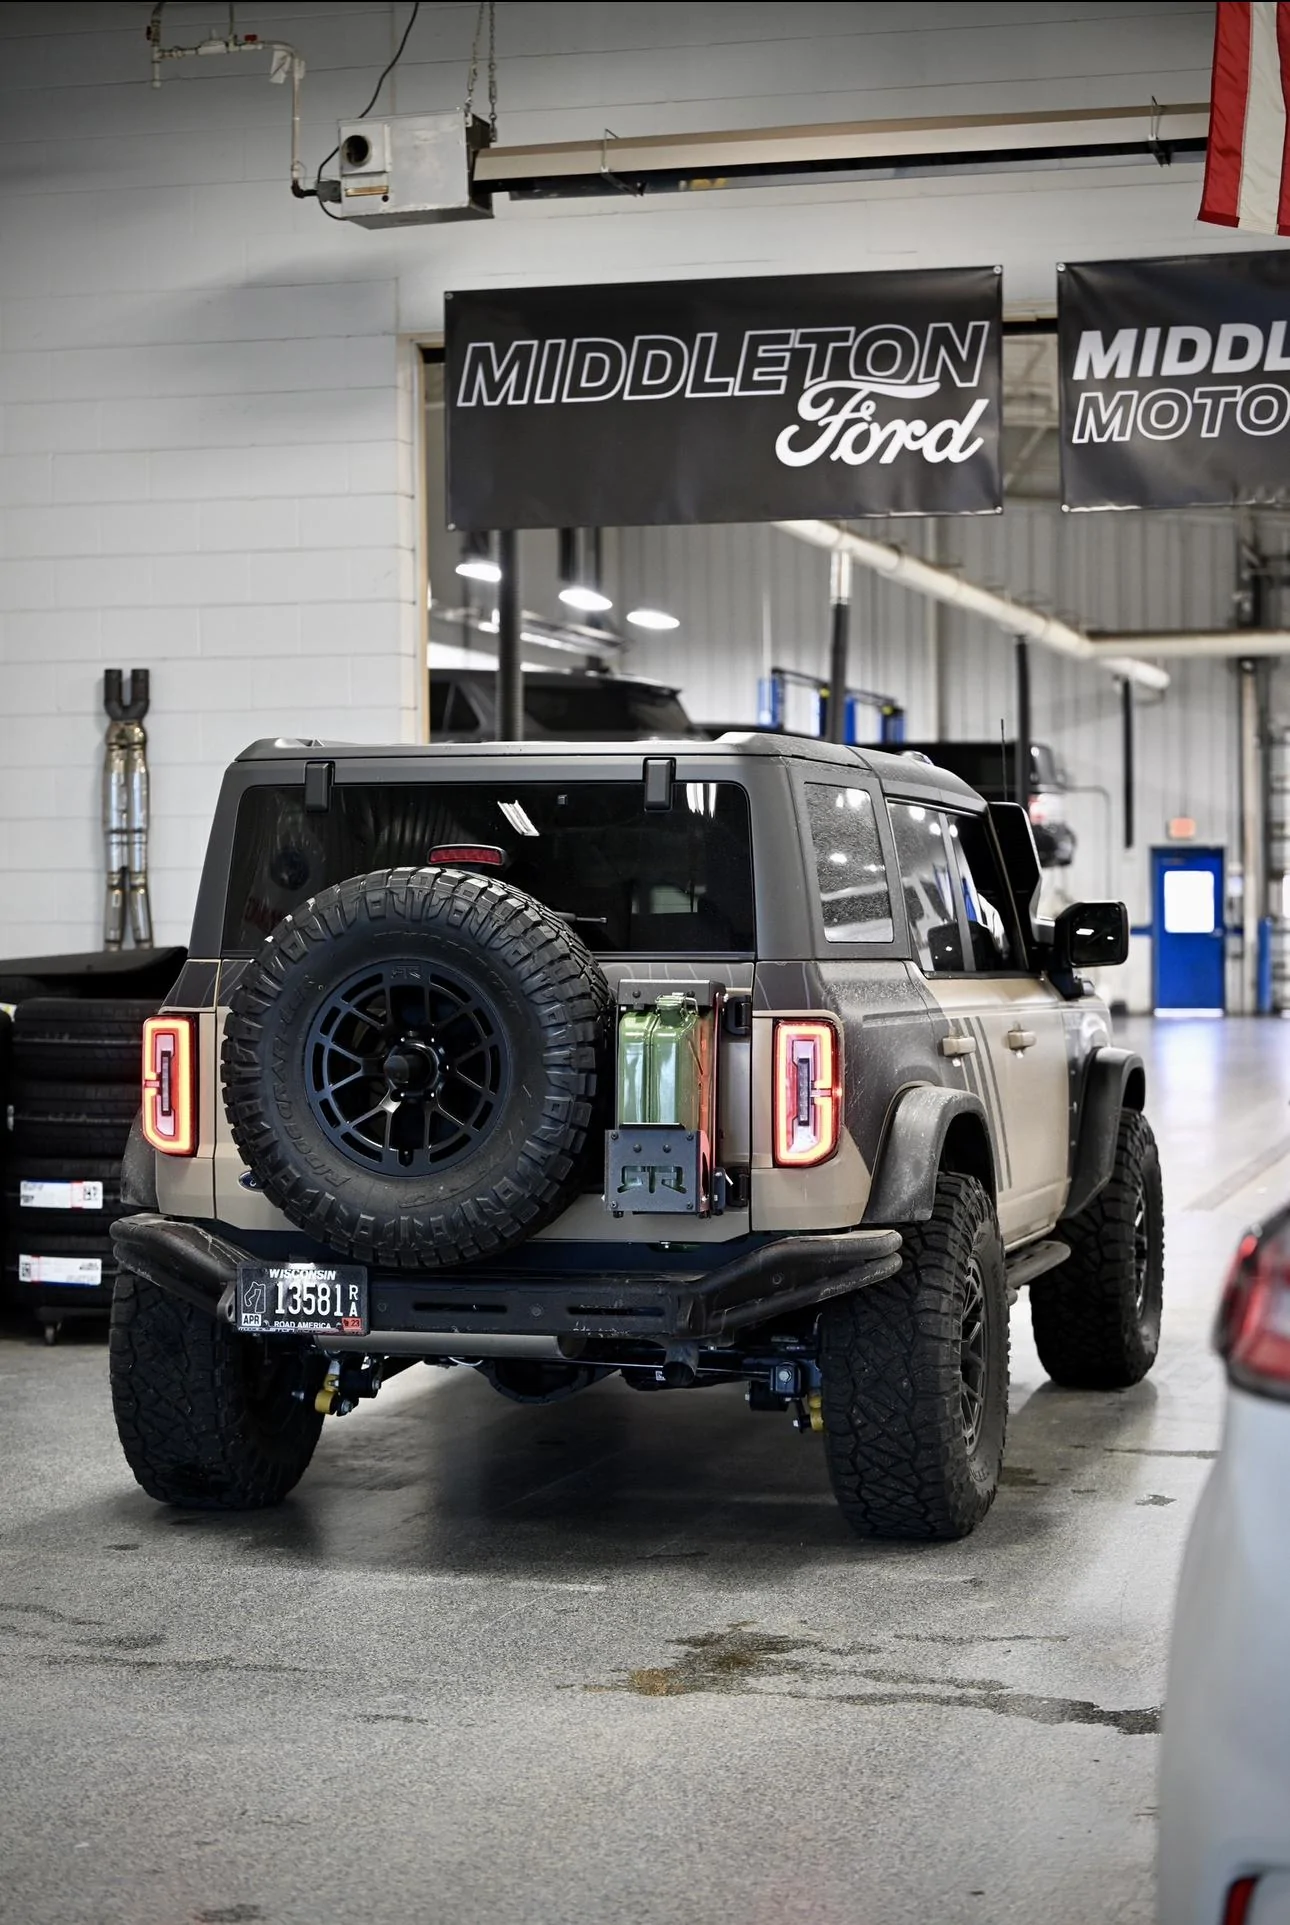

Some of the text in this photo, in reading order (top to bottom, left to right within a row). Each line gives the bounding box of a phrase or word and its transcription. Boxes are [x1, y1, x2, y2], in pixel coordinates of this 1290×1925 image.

[456, 320, 990, 407] MIDDLETON
[1072, 320, 1290, 381] MIDDL
[775, 380, 990, 467] Ford
[1072, 383, 1290, 444] MOTO
[269, 1268, 337, 1281] WISCONSIN
[242, 1314, 260, 1325] APR
[274, 1281, 344, 1317] 13581
[274, 1320, 331, 1329] ROAD AMERICA
